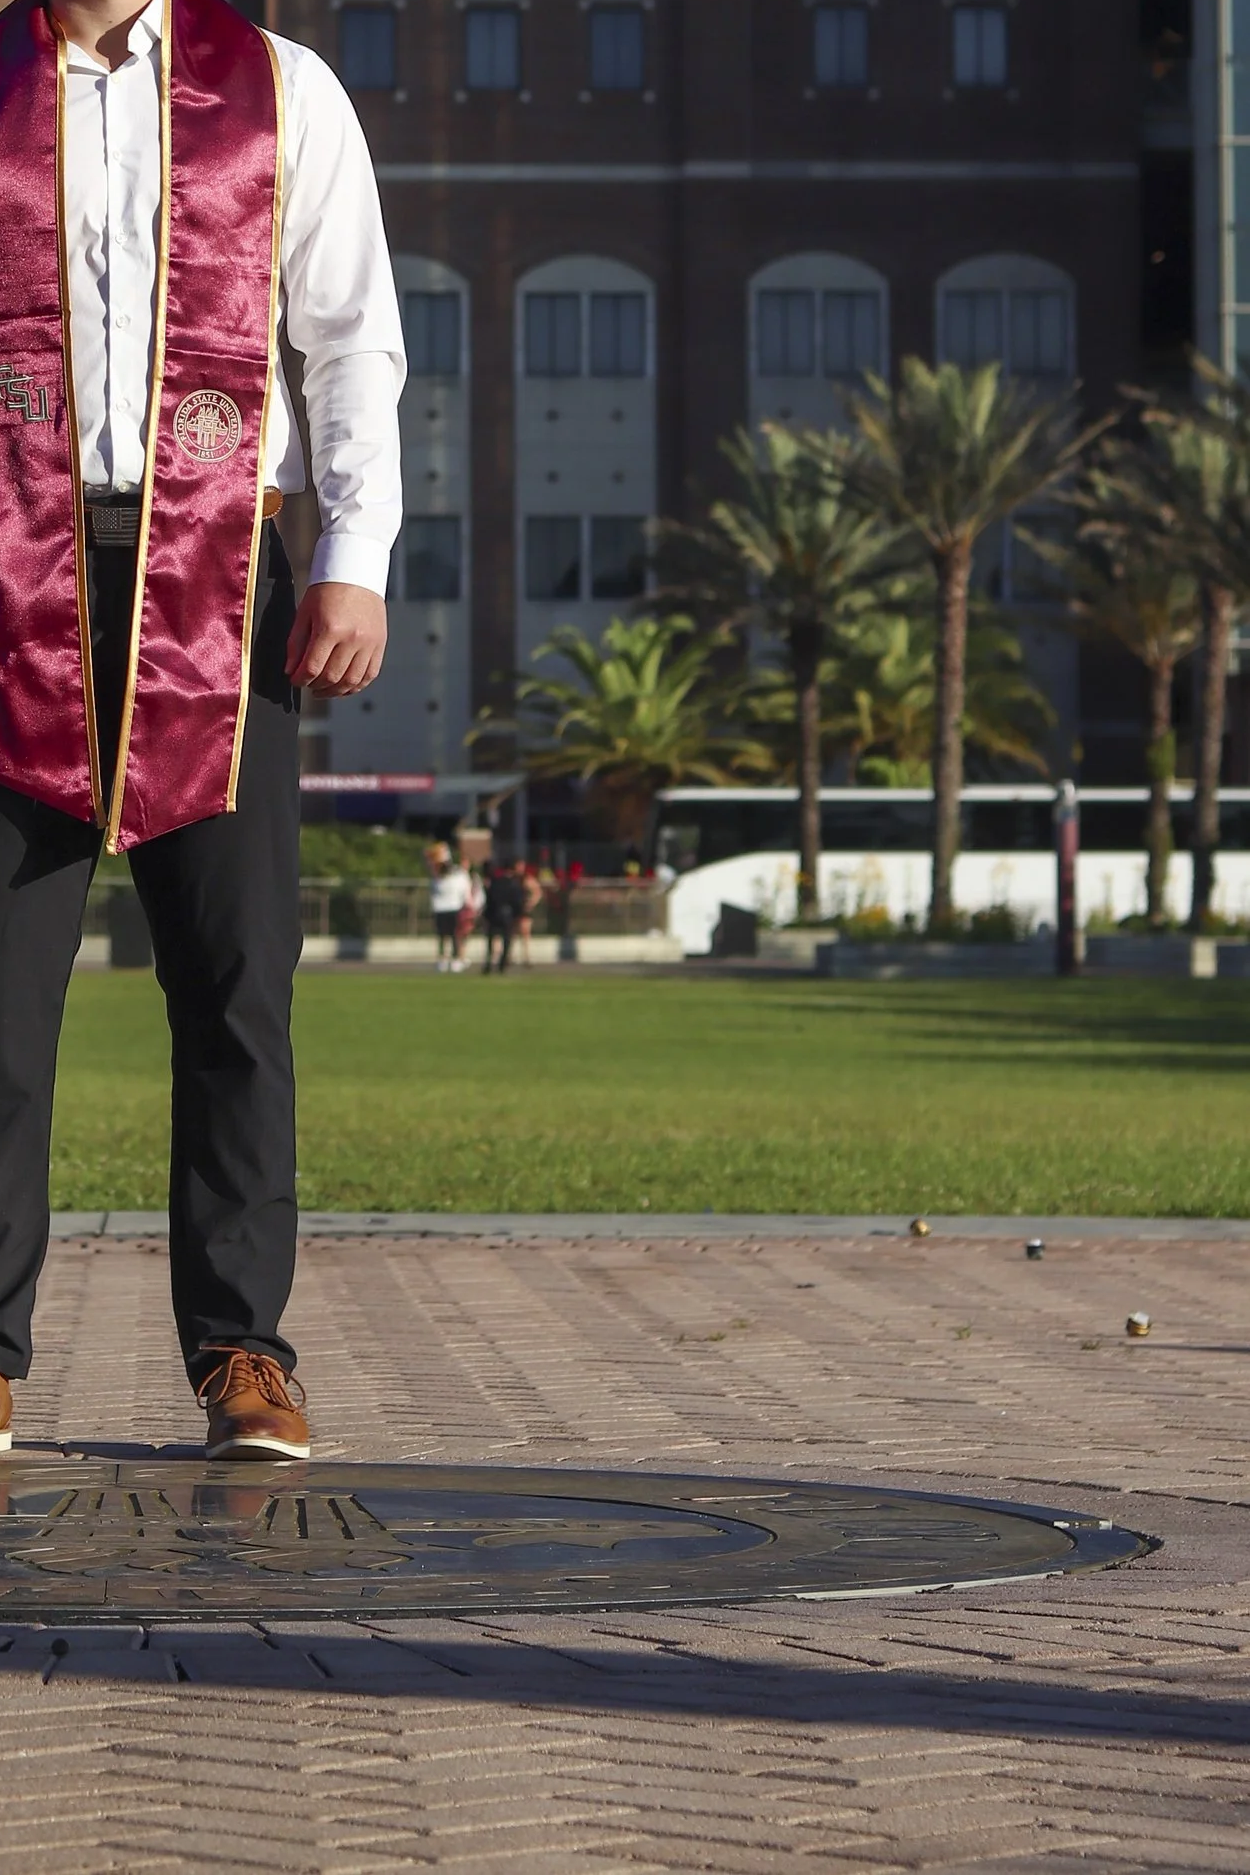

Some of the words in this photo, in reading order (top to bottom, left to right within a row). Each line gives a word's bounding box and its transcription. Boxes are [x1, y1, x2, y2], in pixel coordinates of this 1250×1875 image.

[177, 403, 193, 442] FLORIDA
[192, 394, 218, 405] STATE
[219, 398, 238, 449] UNIVERSITY
[197, 450, 215, 458] 1851
